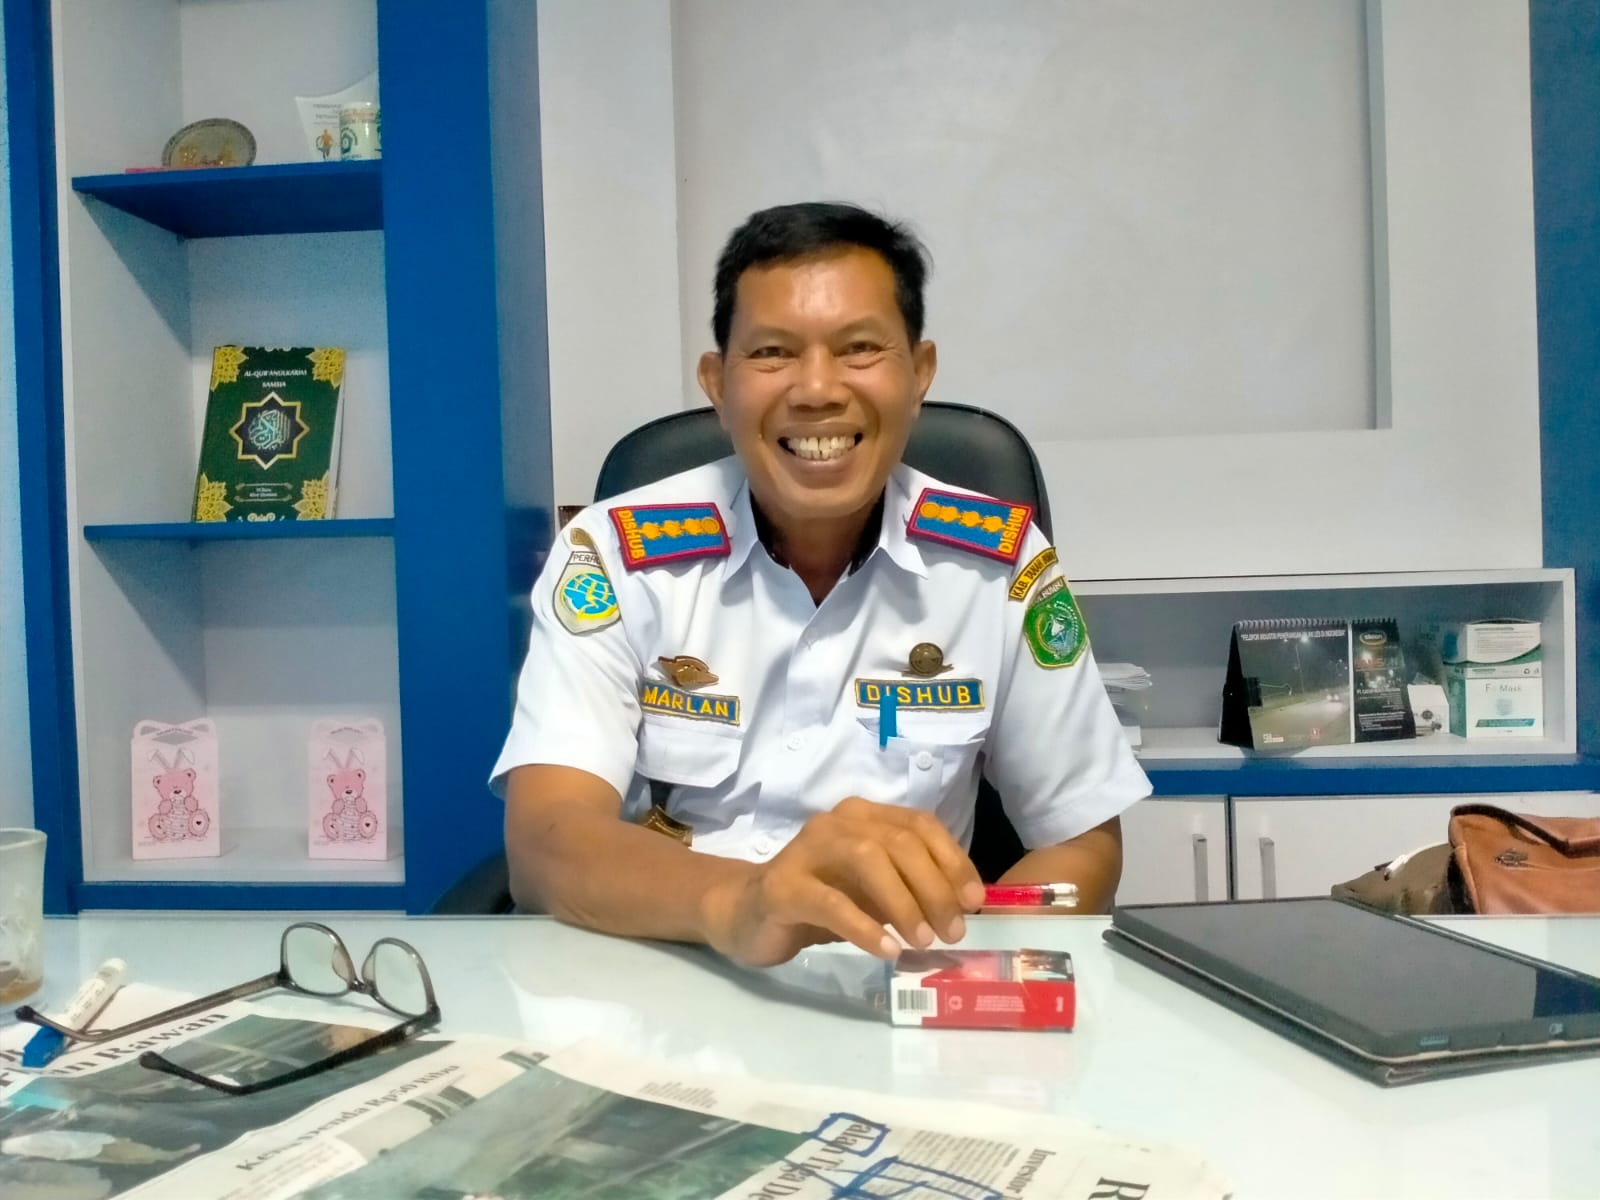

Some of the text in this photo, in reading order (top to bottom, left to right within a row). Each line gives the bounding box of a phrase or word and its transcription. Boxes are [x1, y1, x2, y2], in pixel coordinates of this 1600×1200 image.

[617, 510, 646, 560] DISHUB
[998, 507, 1028, 554] DISHUB
[643, 685, 730, 718] MARLAN
[93, 1012, 229, 1061] Rawan
[1006, 1148, 1057, 1194] Investor
